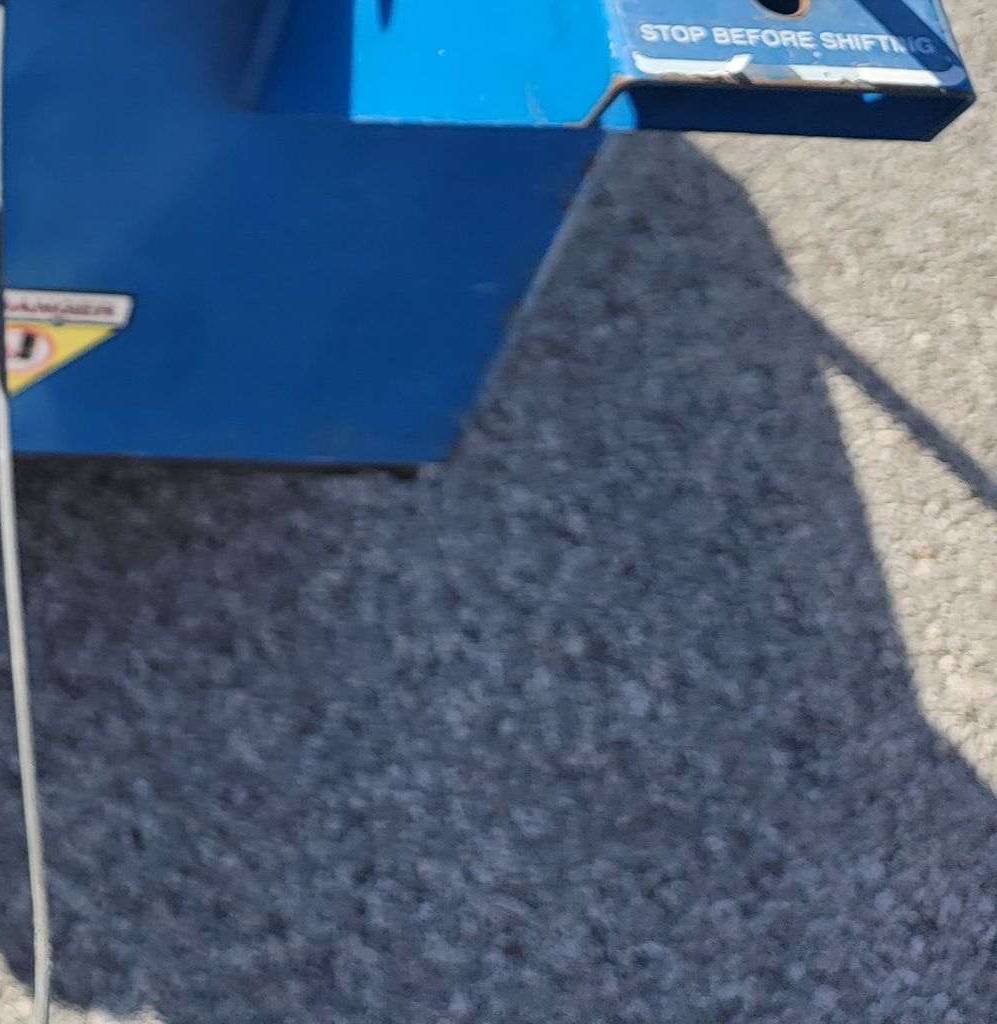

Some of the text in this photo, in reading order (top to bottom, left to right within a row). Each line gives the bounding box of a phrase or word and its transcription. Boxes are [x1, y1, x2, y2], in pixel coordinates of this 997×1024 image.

[639, 24, 936, 55] STOP BEFORE SHIFTING
